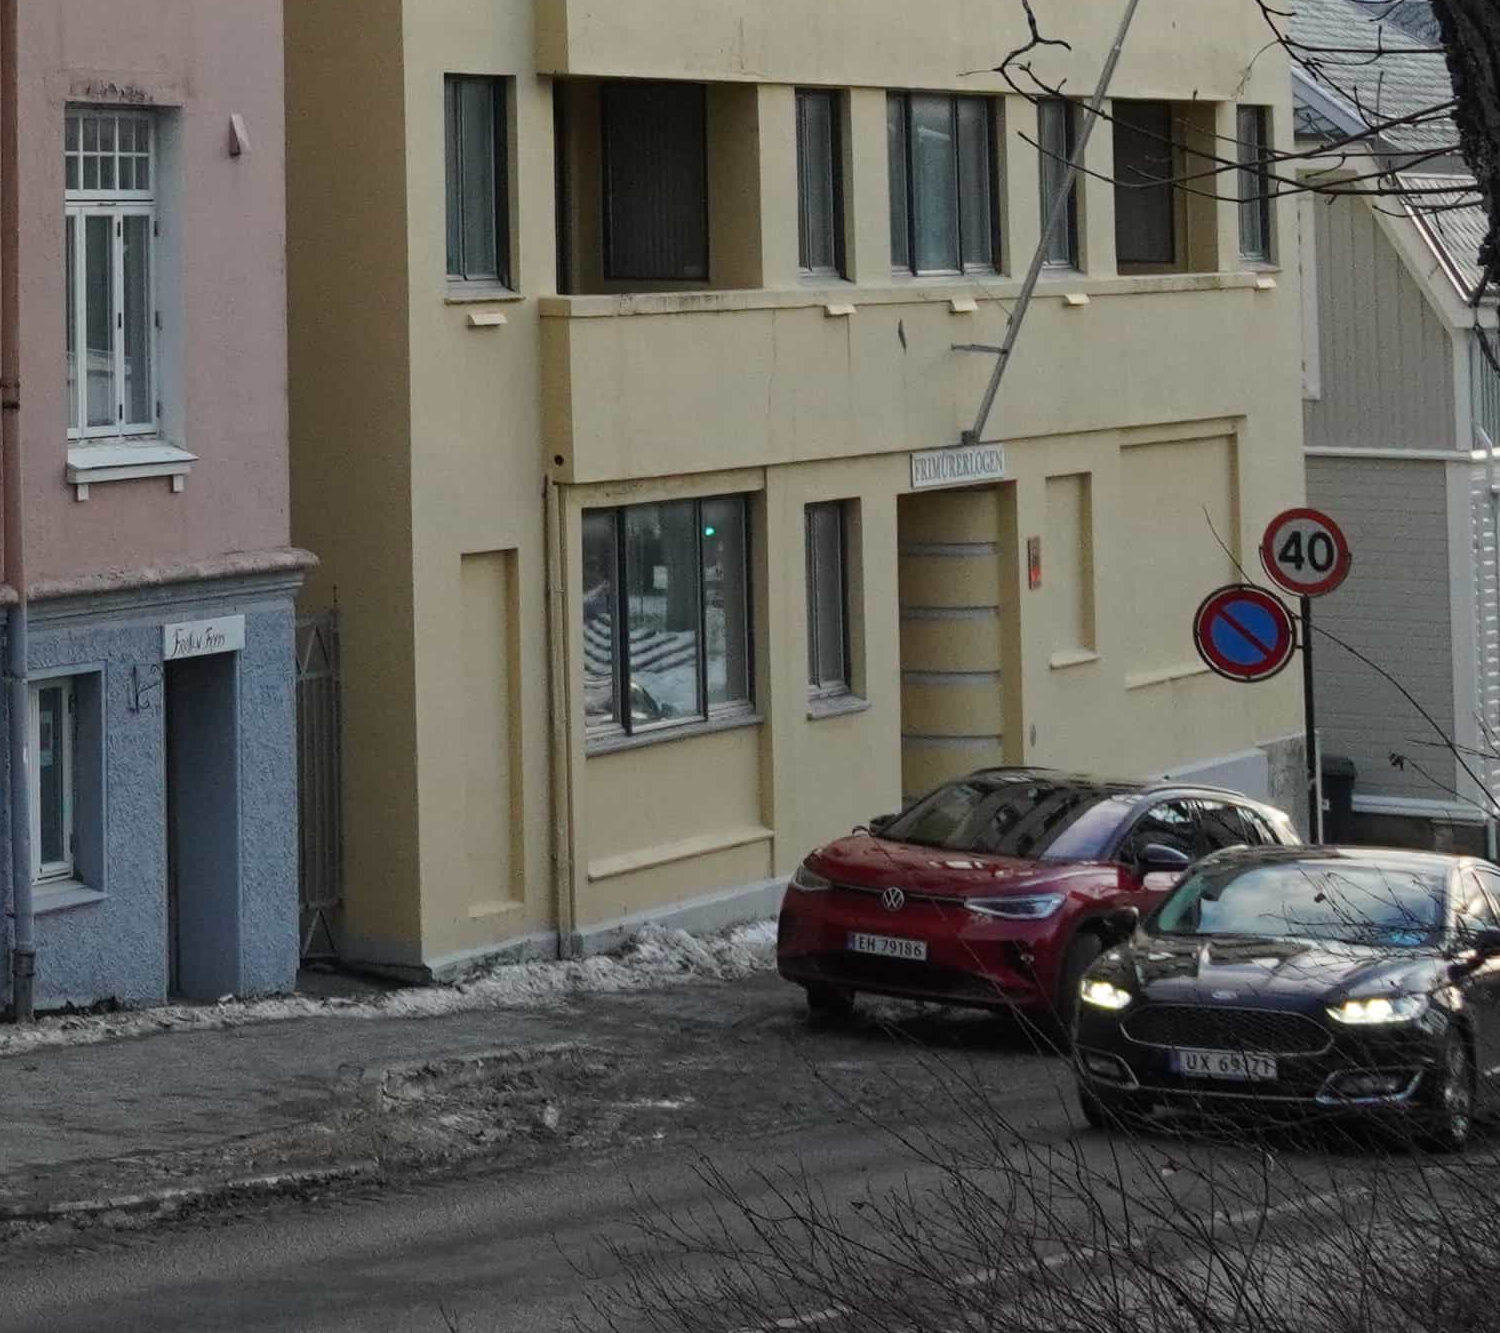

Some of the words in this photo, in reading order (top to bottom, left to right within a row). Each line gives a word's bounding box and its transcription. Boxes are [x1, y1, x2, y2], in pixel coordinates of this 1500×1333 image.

[1278, 530, 1335, 572] 40
[859, 936, 876, 952] EH
[880, 939, 923, 958] 79186
[1186, 1053, 1211, 1071] UX
